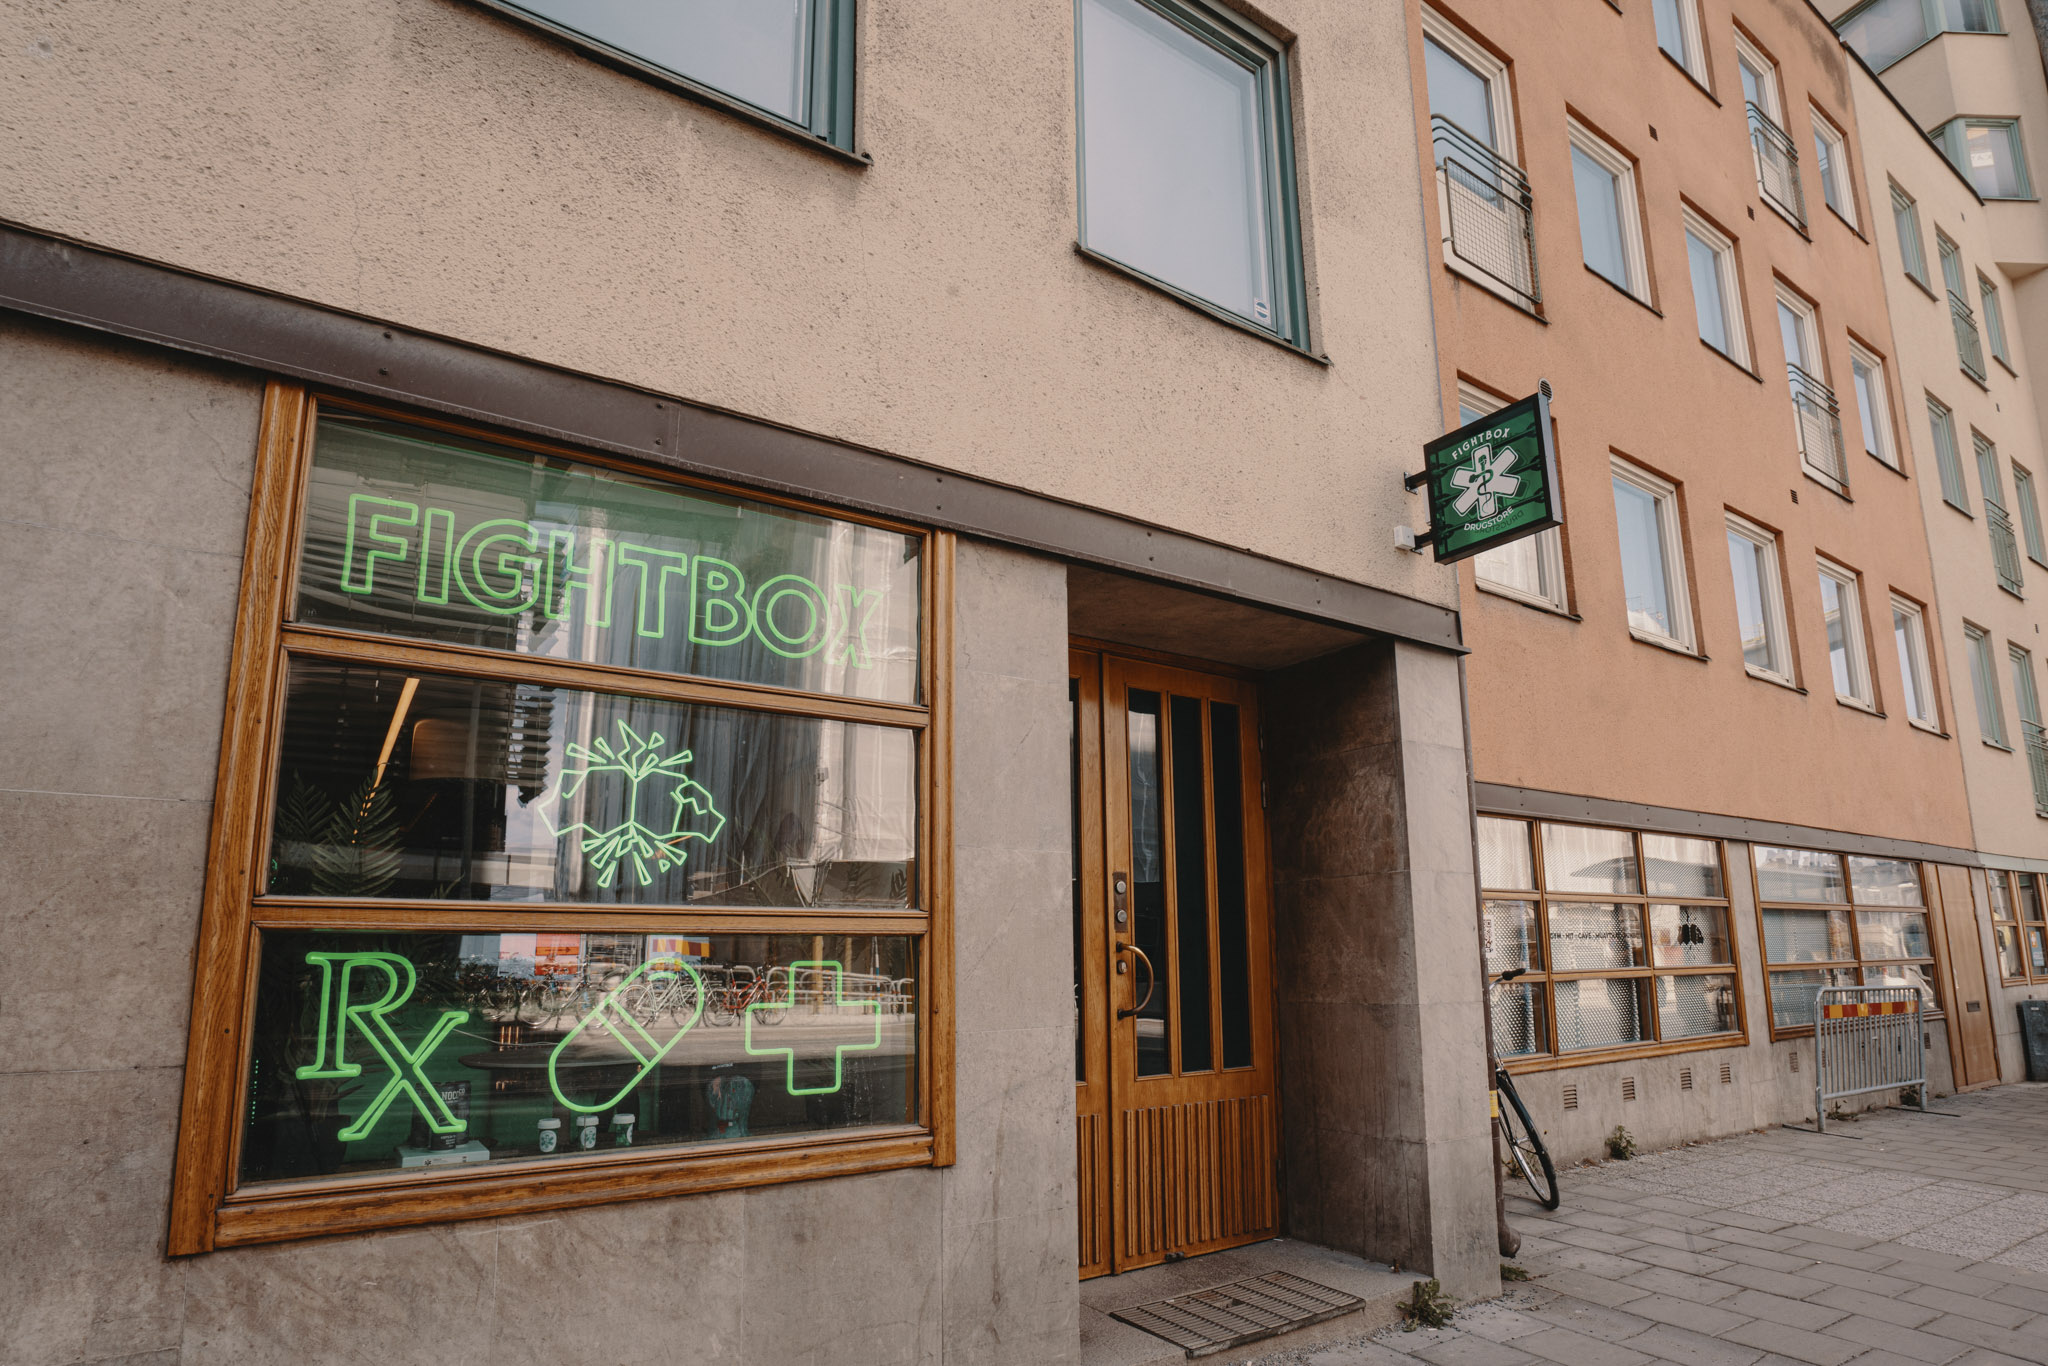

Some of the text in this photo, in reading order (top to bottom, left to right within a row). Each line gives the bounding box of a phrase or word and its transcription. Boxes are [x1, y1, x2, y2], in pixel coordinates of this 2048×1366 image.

[1452, 428, 1510, 460] FIGHTBOX
[1464, 506, 1514, 531] DRUGSTORE
[340, 493, 884, 670] FIGHTBOX
